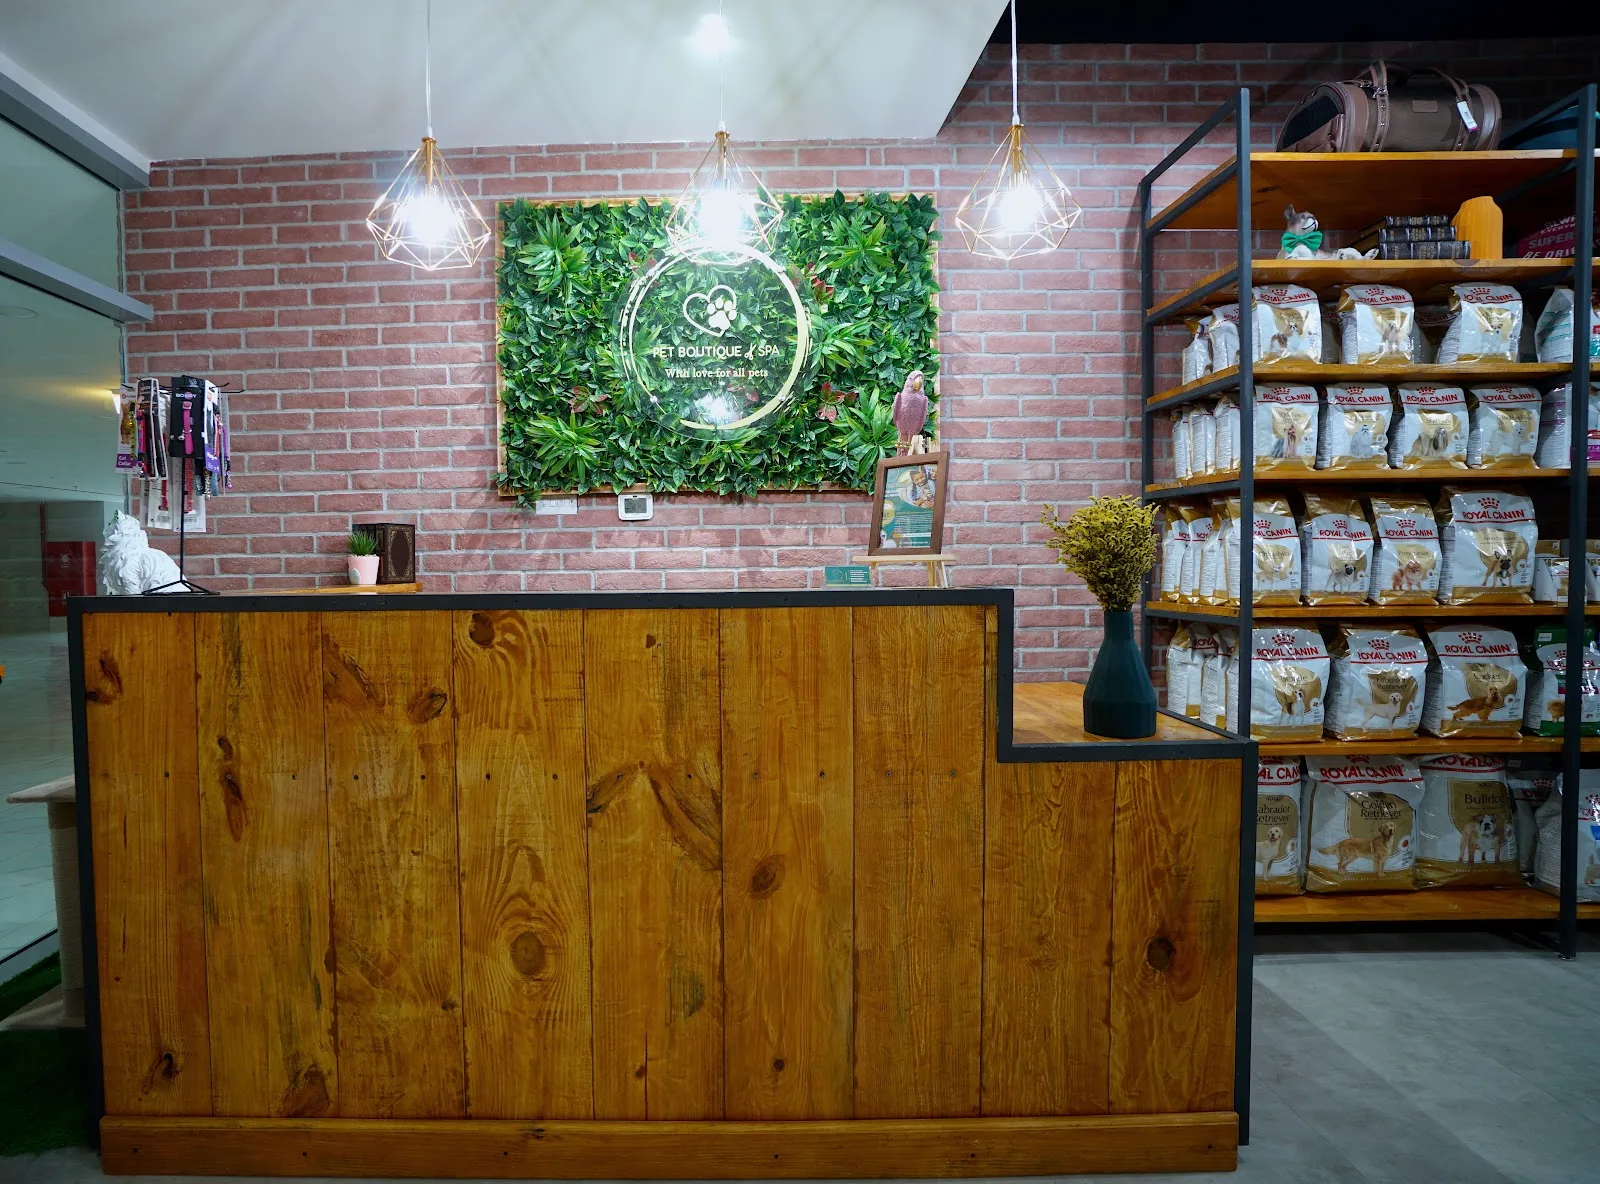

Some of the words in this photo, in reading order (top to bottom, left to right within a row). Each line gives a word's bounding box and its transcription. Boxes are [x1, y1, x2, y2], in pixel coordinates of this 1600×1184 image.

[1260, 293, 1281, 302] ROYAL
[1281, 292, 1310, 302] CANIN
[1379, 294, 1406, 303] CANIN
[1485, 293, 1513, 302] CANIN
[652, 346, 675, 358] PET
[678, 345, 742, 359] BOUTIQUE
[757, 344, 780, 357] SPA
[665, 368, 690, 378] With
[693, 368, 712, 378] love
[716, 368, 733, 378] for
[733, 367, 745, 377] all
[748, 369, 769, 380] pets
[1263, 393, 1282, 401] ROYAL
[1284, 393, 1311, 401] CANIN
[1334, 395, 1355, 403] ROYAL
[1357, 395, 1384, 403] CANIN
[1406, 395, 1427, 403] ROYAL
[1429, 394, 1458, 403] CANIN
[1462, 511, 1492, 520] ROYAL
[1492, 509, 1525, 520] CANIN
[1265, 528, 1292, 537] CANIN
[1319, 529, 1342, 537] ROYAL
[1344, 530, 1366, 539] CANIN
[1385, 529, 1408, 537] ROYAL
[1409, 529, 1434, 537] CANIN
[1256, 647, 1286, 657] ROYAL
[1286, 646, 1319, 656] CANIN
[1444, 644, 1475, 654] ROYAL
[1475, 644, 1511, 654] CANIN
[1385, 650, 1417, 660] CANIN
[1257, 766, 1273, 779] AL
[1319, 766, 1364, 779] ROYAL
[1364, 764, 1404, 778] CANIN
[1257, 804, 1291, 814] abrador
[1361, 800, 1398, 810] Golden
[1256, 814, 1290, 823] etriever
[1360, 809, 1402, 818] Retriever
